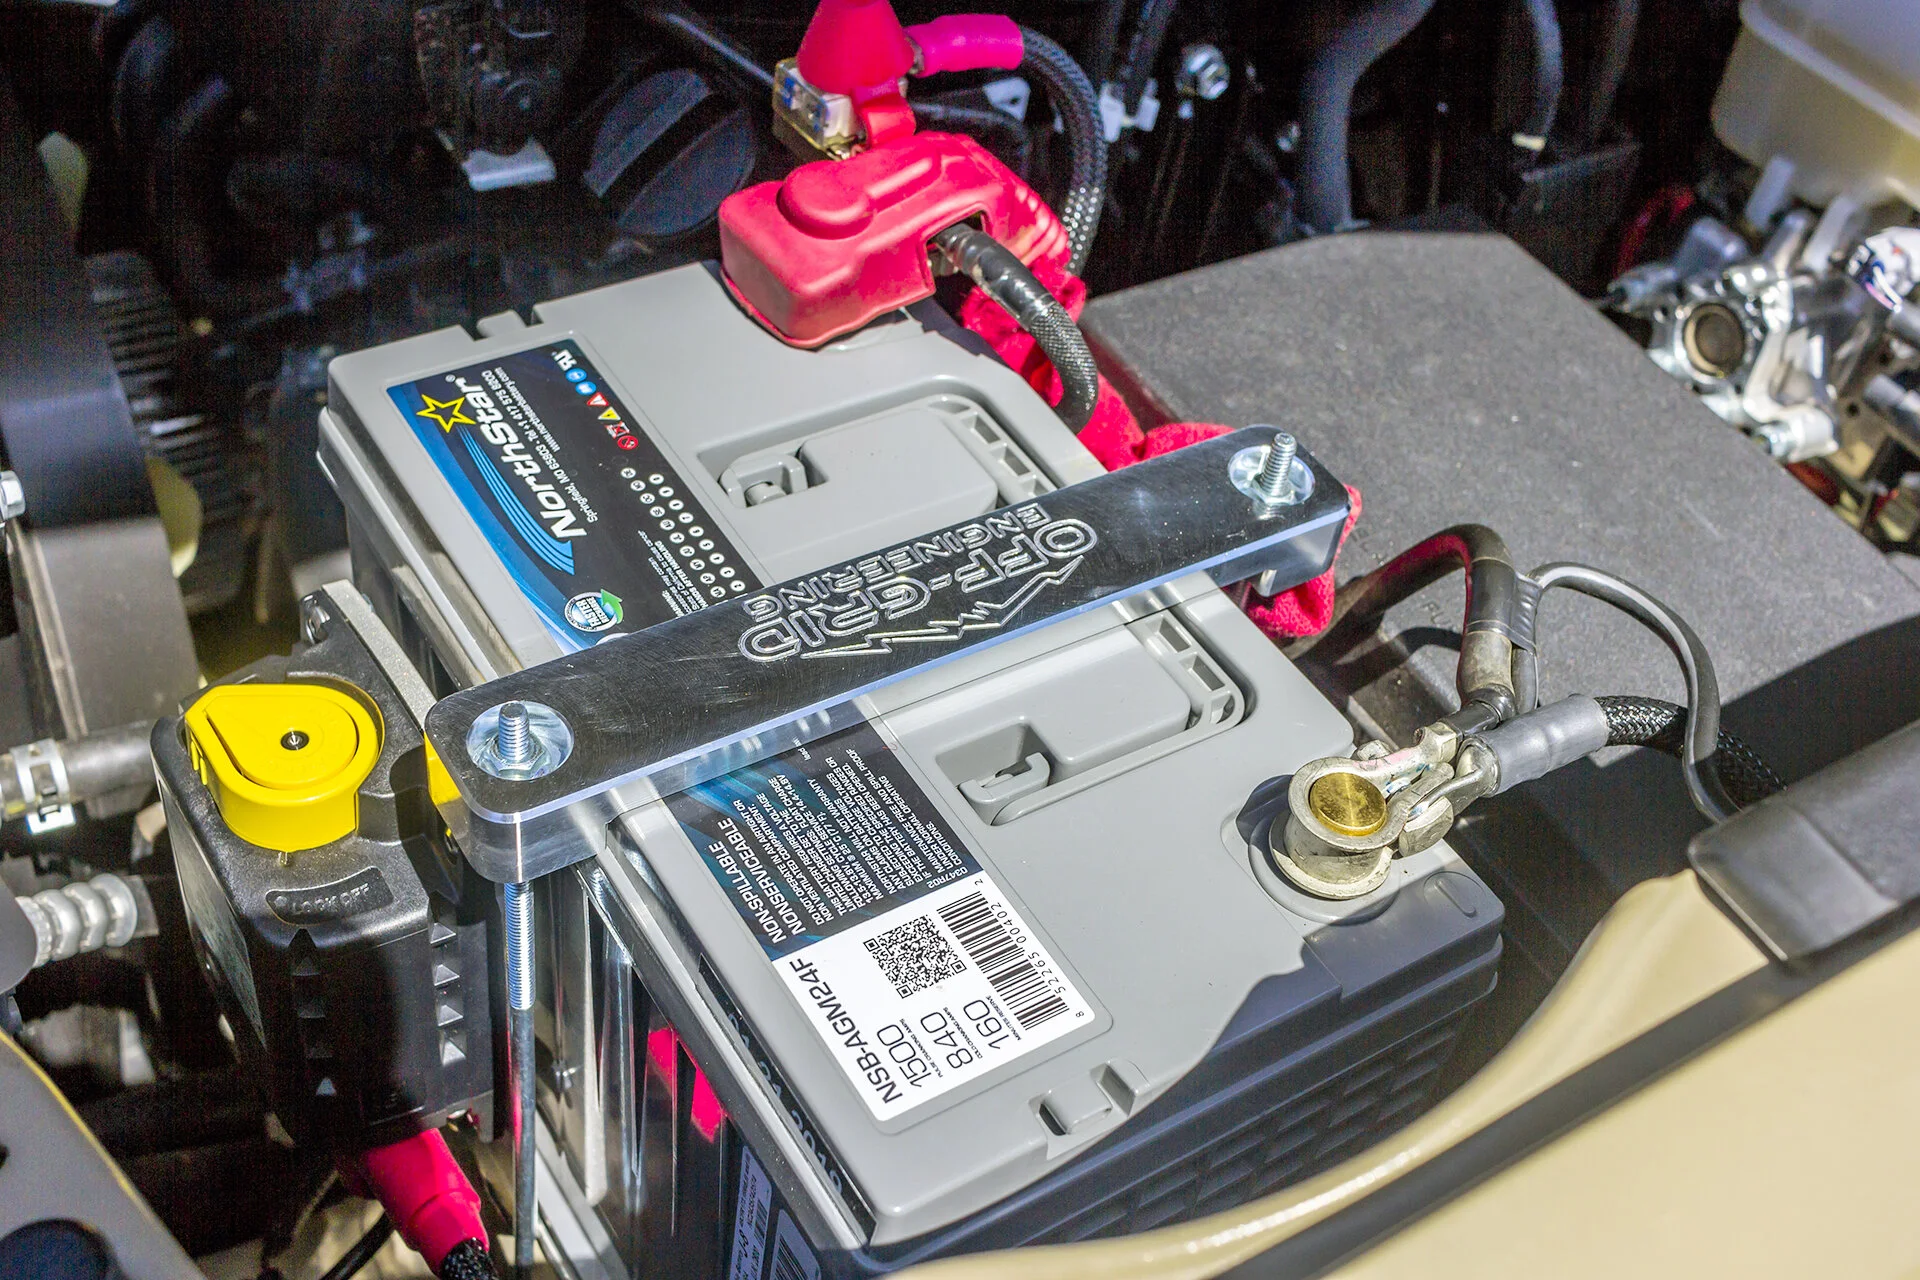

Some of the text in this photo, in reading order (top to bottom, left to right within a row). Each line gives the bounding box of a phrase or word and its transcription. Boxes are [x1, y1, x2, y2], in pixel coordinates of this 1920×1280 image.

[491, 365, 564, 452] www.northstarbattery.com
[494, 389, 514, 405] 575
[504, 404, 525, 421] 417
[516, 419, 532, 430] +1
[523, 429, 540, 442] Tel
[533, 443, 561, 470] 65803
[551, 468, 571, 483] MO
[561, 482, 600, 523] Springfield,
[652, 539, 681, 570] HANDLING
[673, 568, 694, 587] AFTER
[743, 502, 1051, 622] ENGINEERING
[573, 598, 602, 626] FASTER
[667, 585, 693, 613] ccessories
[738, 518, 1097, 662] OFF-GRID
[775, 772, 809, 811] 14.4-14.8V
[824, 755, 924, 883] EXCEEDING THE SPECIFIED RANGES OR
[839, 761, 933, 879] IF THE BATTERY HAS BEEN OPENED.
[844, 746, 946, 873] MAINTENANCE FREE AND SPILL PROOF
[767, 776, 866, 907] FOLLOWING SETTINGS: FLOAT CHARGE
[802, 809, 830, 840] SERVICE
[806, 777, 898, 894] NORTHSTAR WILL NOT WARRANTY
[822, 838, 846, 863] CYCLE
[824, 771, 915, 886] SUBJECTED TO CHARGE VOLTAGES
[832, 797, 906, 890] ANY CLAIMS ON BATTERIES
[876, 774, 954, 869] UNDER NORMAL OPERATING
[922, 820, 963, 866] CONDITIONS.
[716, 816, 807, 935] NONSERVICEABLE
[732, 798, 826, 925] DO NOT OPERATE IN AN AIRTIGHT OR
[746, 802, 835, 921] NON VENTILATED COMPARTMENT.
[755, 791, 848, 916] THIS BATTERY REQUIRES A VOLTAGE
[778, 808, 857, 912] LIMITED CHARGER SET TO THE
[850, 859, 884, 900] MAXIMUM
[925, 865, 969, 888] 0347R02
[707, 840, 788, 944] NON-SPILLABLE
[989, 901, 1027, 944] 00402
[1027, 950, 1066, 994] 52265
[788, 954, 903, 1104] NSB-AGM24F
[917, 1009, 975, 1070] 840
[960, 997, 1014, 1052] 160
[873, 1022, 936, 1090] 1500
